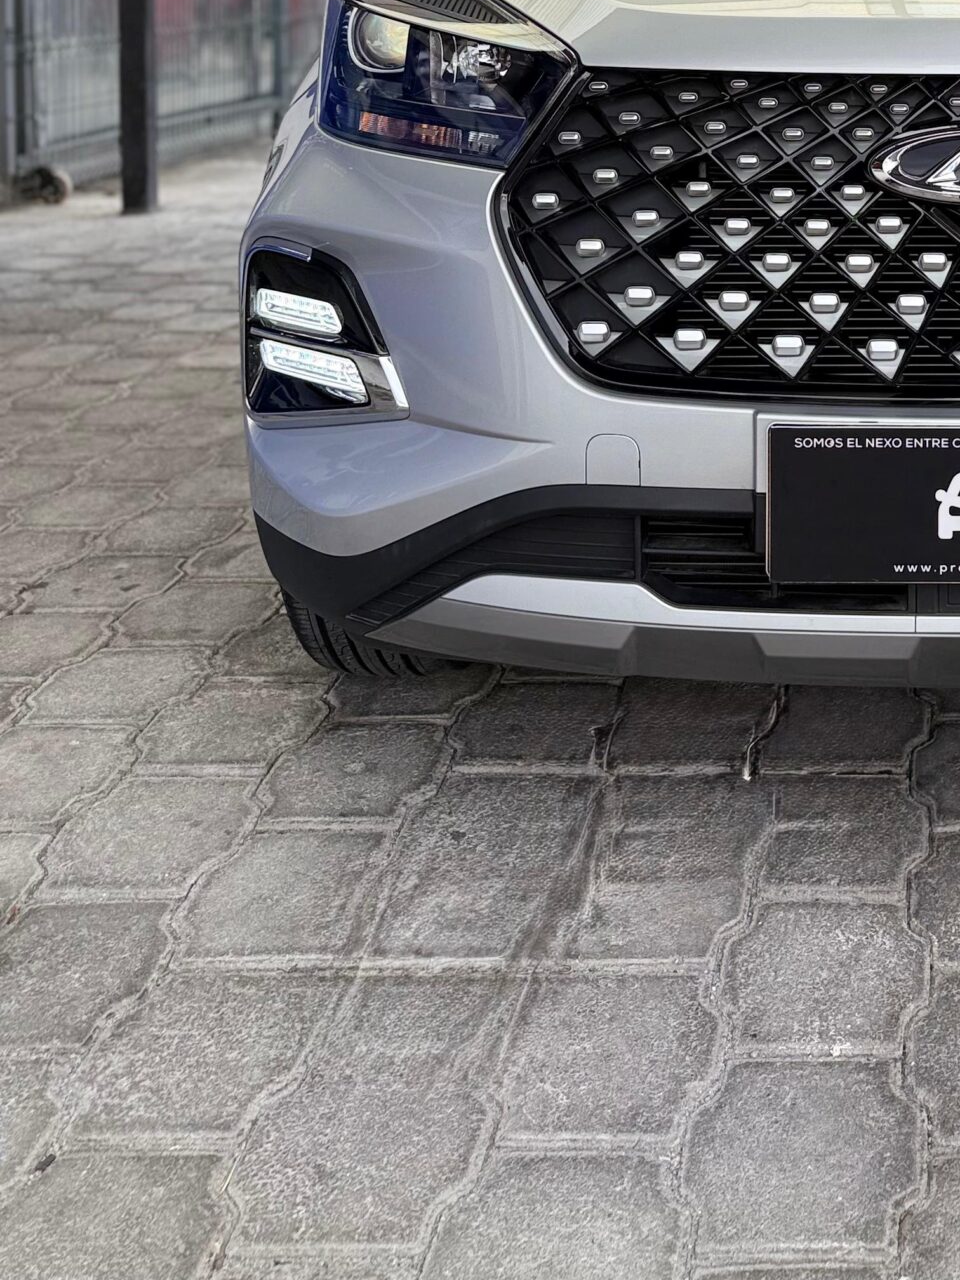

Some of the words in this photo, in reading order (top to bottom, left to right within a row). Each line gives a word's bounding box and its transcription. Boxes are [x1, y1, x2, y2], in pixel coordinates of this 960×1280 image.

[794, 437, 844, 449] SOMOS
[847, 438, 863, 449] EL
[865, 438, 902, 449] NEXO
[905, 438, 949, 449] ENTRE
